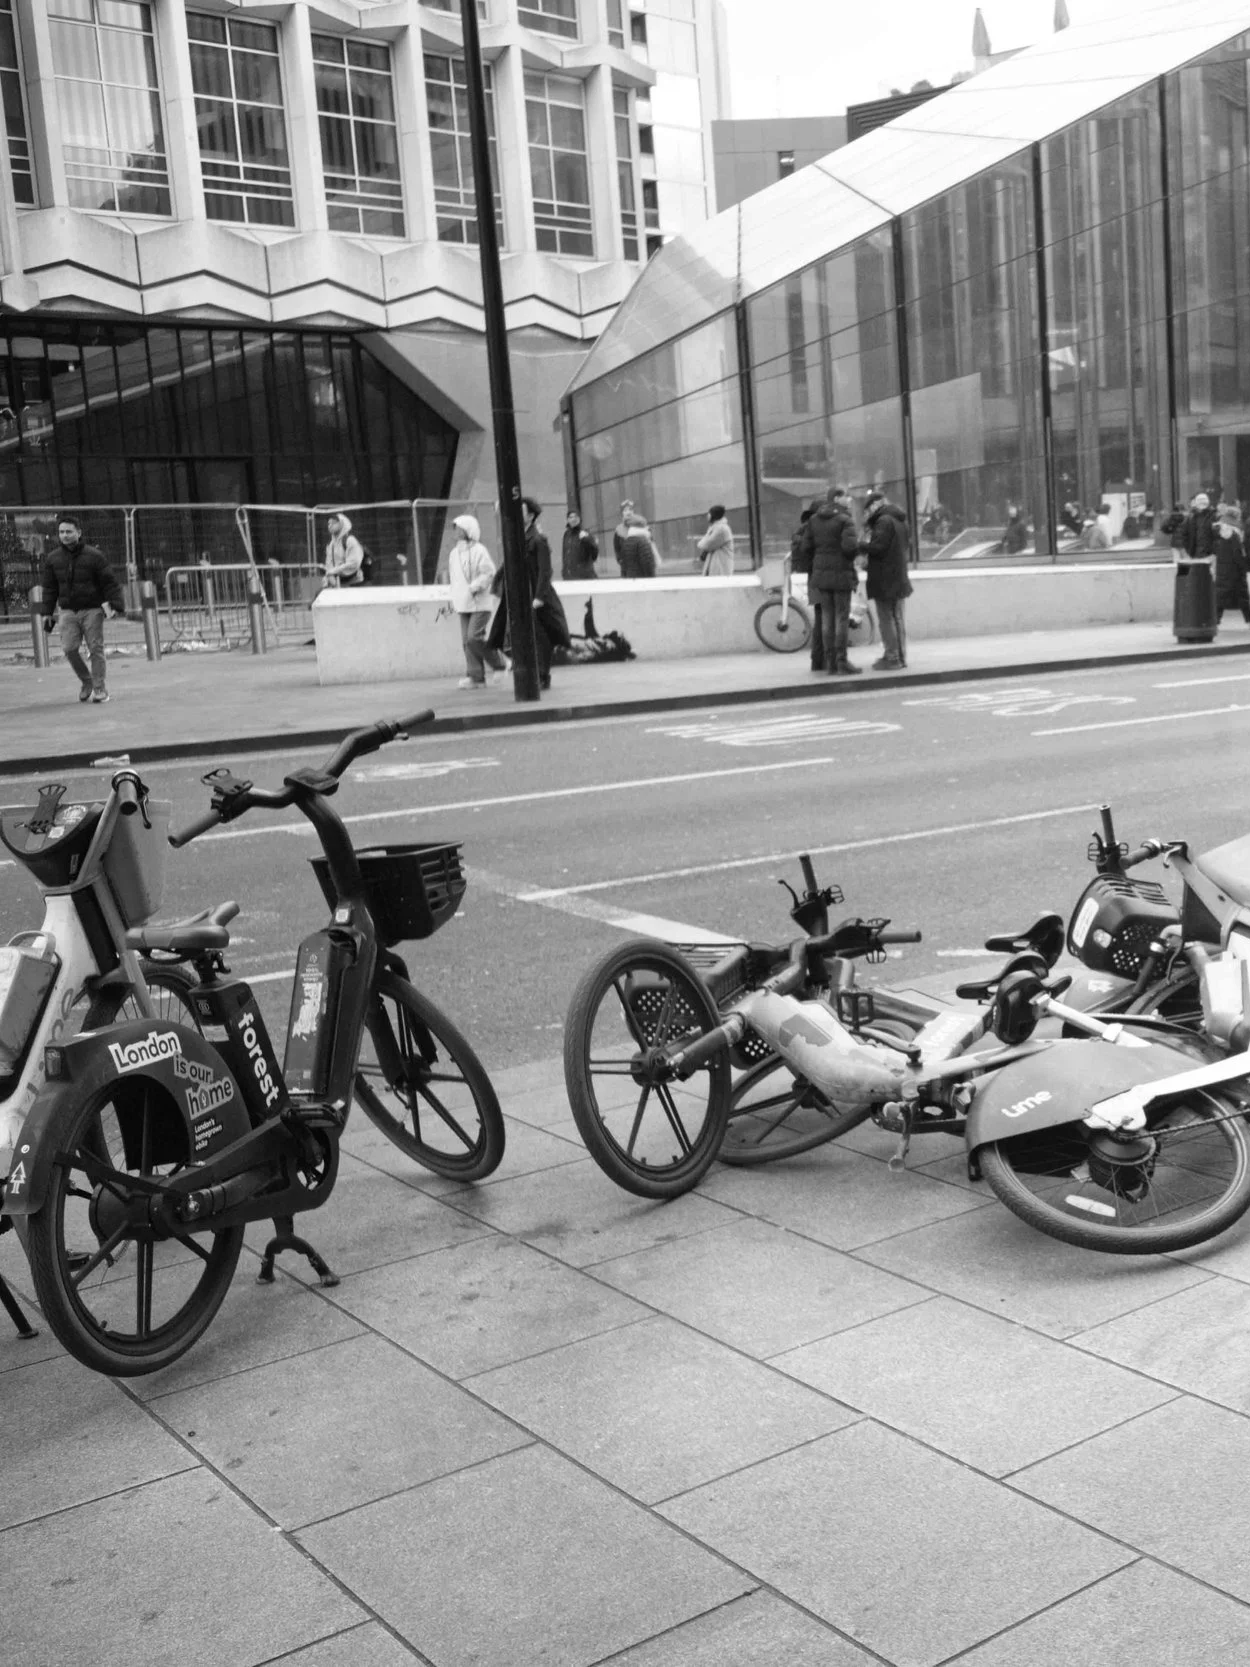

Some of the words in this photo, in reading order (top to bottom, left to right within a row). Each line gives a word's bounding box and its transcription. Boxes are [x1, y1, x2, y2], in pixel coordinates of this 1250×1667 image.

[112, 1034, 180, 1070] London
[238, 1012, 280, 1108] forest
[175, 1056, 187, 1074] is
[190, 1064, 212, 1083] our
[187, 1079, 232, 1116] home
[1001, 1091, 1052, 1118] Lime
[194, 1118, 216, 1133] London's
